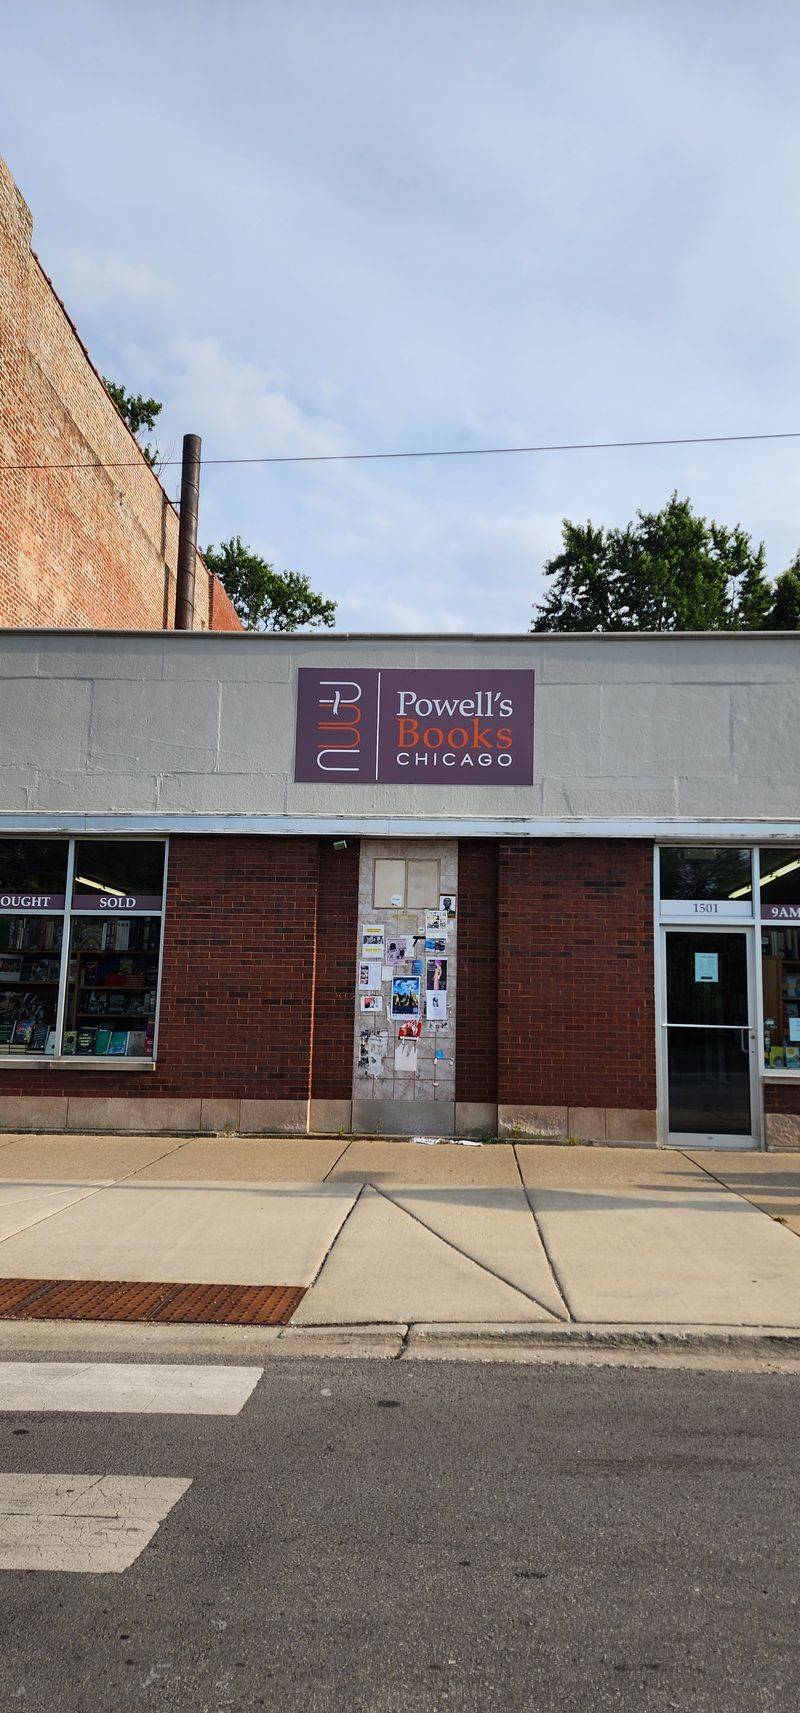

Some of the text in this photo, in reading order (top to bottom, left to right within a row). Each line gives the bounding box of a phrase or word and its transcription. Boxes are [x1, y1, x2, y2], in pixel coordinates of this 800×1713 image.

[396, 691, 513, 717] Powell's
[396, 718, 513, 749] Books
[396, 752, 513, 767] CHICAGO
[99, 897, 136, 908] SOLD
[693, 903, 718, 913] 1501
